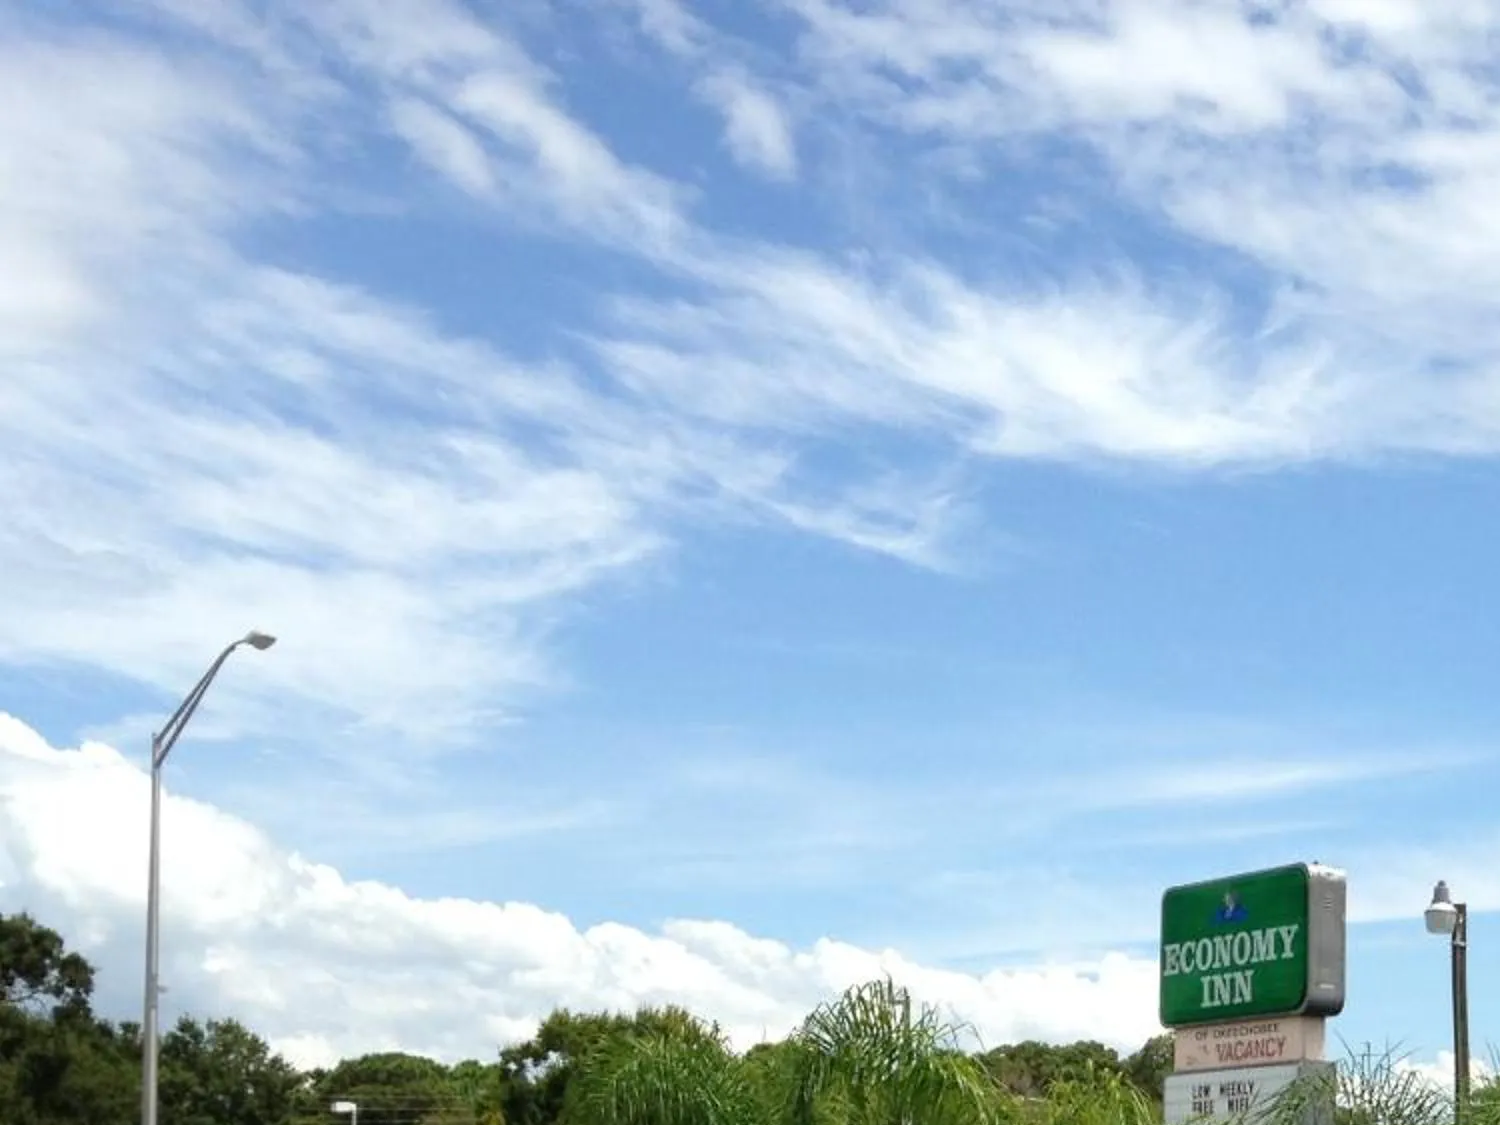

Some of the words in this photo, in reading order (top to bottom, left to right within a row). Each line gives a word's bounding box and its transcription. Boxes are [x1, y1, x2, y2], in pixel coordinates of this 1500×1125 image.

[1163, 925, 1298, 975] ECONOMY
[1201, 971, 1254, 1007] INN
[1215, 1037, 1287, 1062] VACANCY
[1191, 1084, 1210, 1099] LOW
[1219, 1080, 1255, 1096] WEEKLY
[1192, 1100, 1214, 1115] FREE
